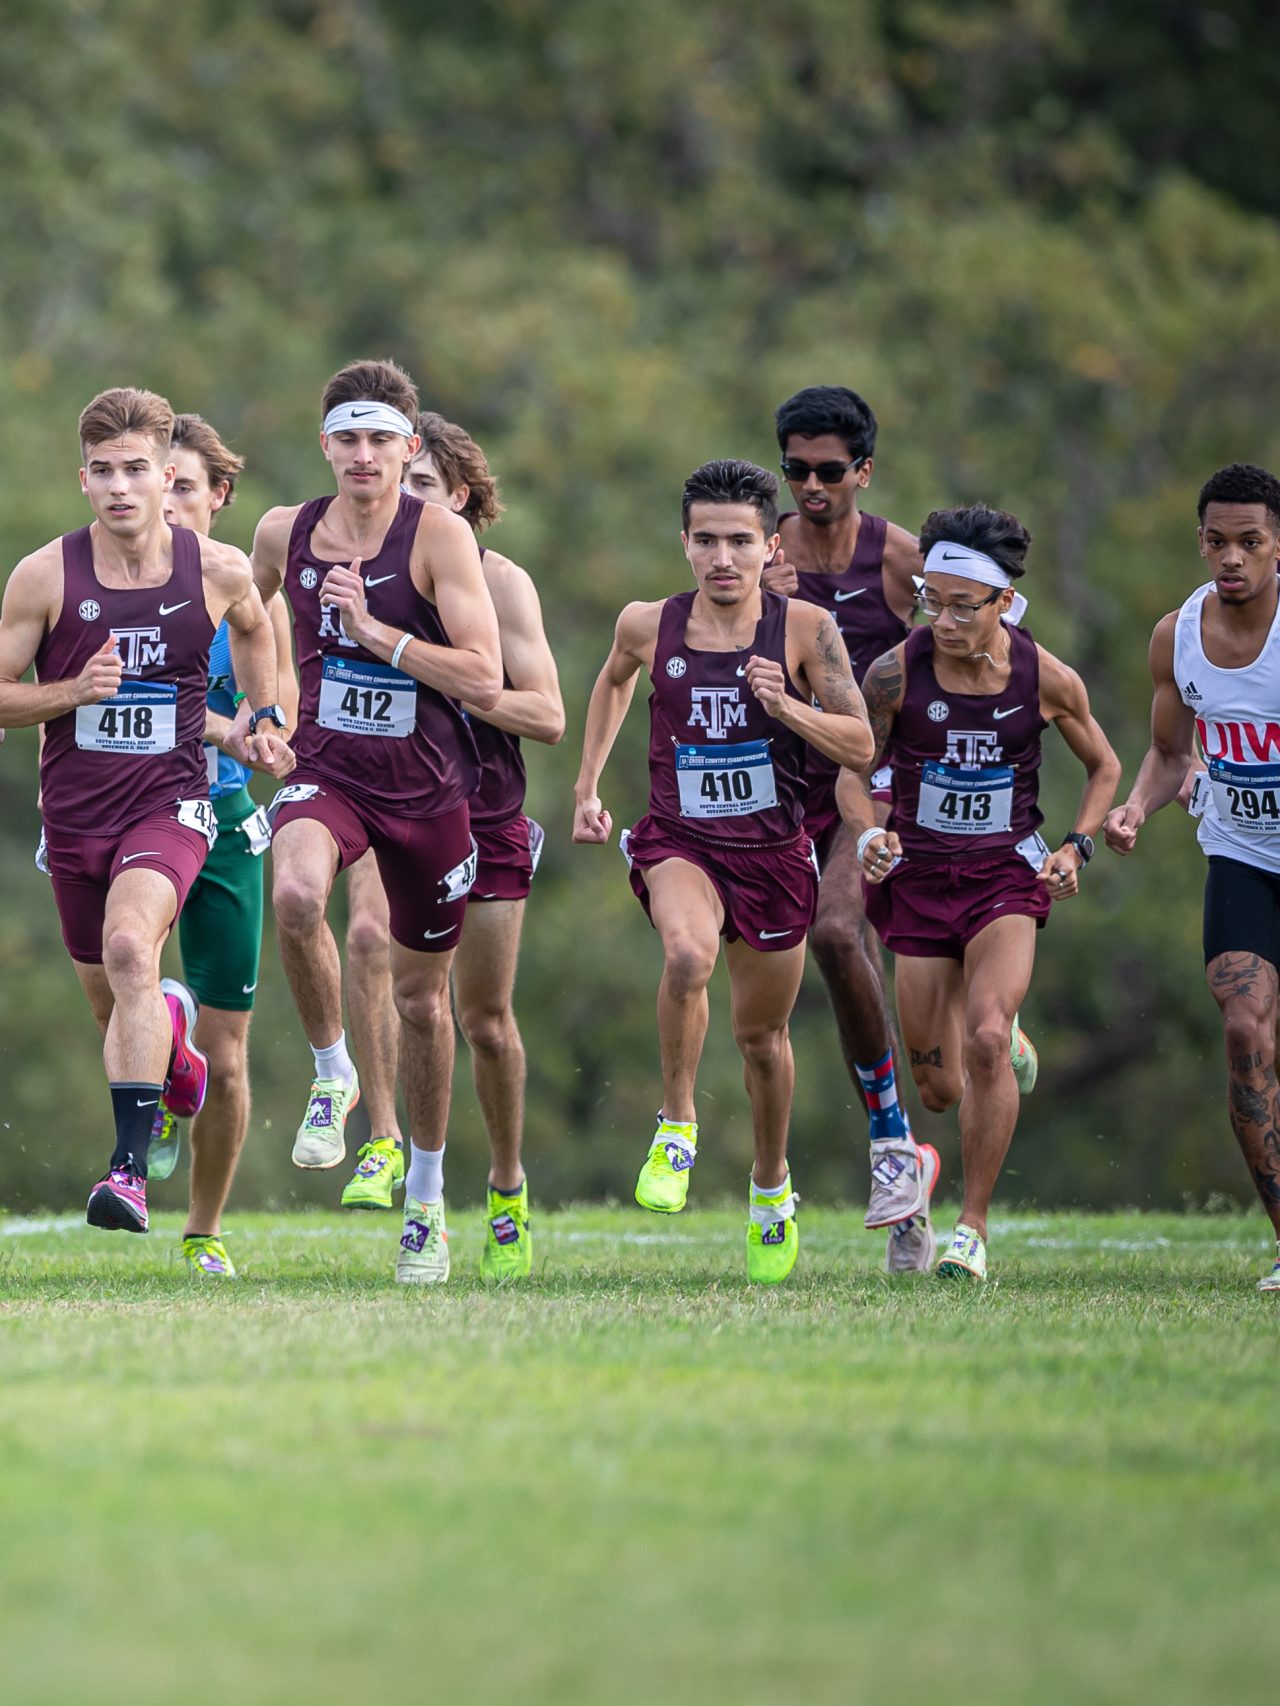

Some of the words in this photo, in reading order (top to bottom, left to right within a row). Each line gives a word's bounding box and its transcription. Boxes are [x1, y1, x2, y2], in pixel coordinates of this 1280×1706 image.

[81, 601, 99, 619] SEC
[668, 658, 685, 678] SEC
[341, 687, 393, 721] 412
[929, 703, 948, 721] SEC
[99, 707, 152, 738] 418
[701, 770, 752, 802] 410
[939, 792, 991, 820] 413
[1227, 787, 1280, 819] 294
[313, 1118, 330, 1126] LYNX
